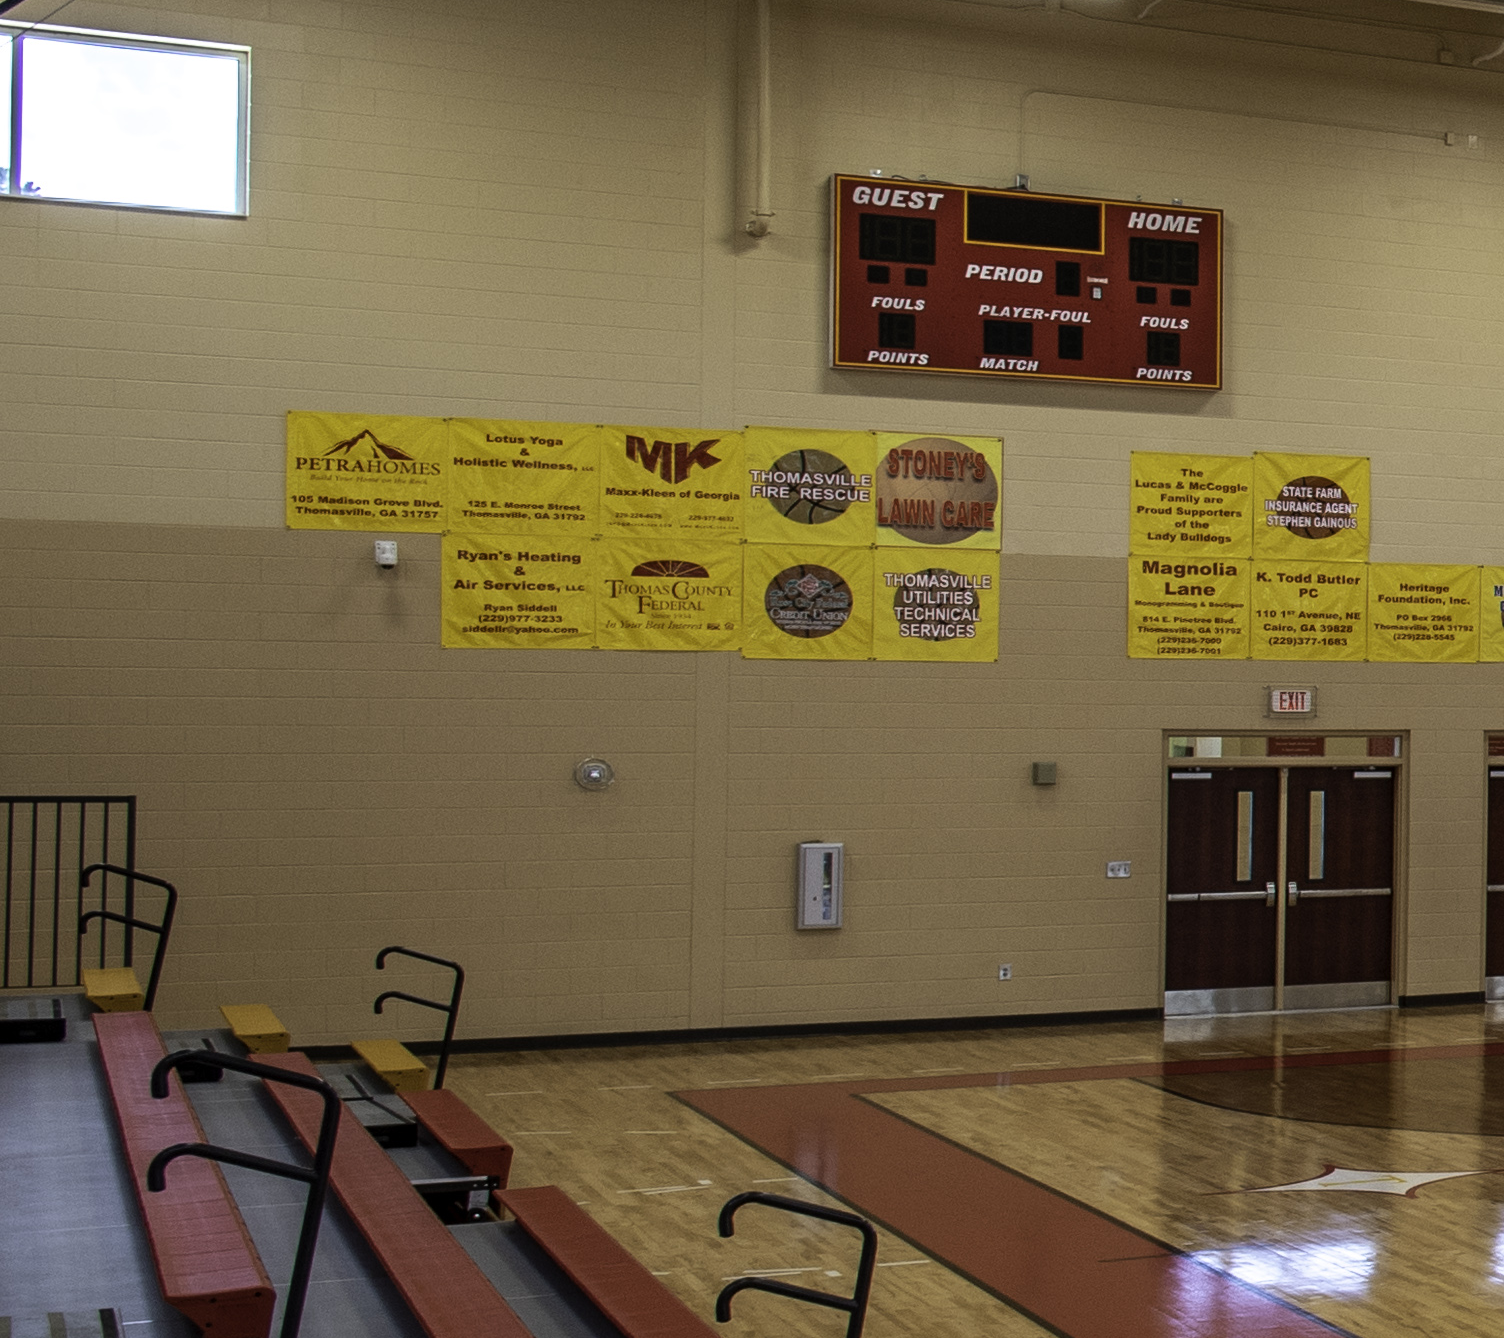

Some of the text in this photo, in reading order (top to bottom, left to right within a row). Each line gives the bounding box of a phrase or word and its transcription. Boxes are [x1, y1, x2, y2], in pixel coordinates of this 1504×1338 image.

[852, 185, 944, 211] GUEST
[1128, 212, 1202, 234] HOME
[965, 264, 1043, 284] PERIOD
[871, 296, 925, 310] FOULS
[978, 304, 1091, 323] PLAYER-FOUL
[1140, 316, 1189, 330] FOULS
[867, 350, 929, 365] POINTS
[980, 358, 1038, 372] MATCH
[1136, 367, 1192, 381] POINTS
[486, 434, 563, 447] Lotus Yoga
[520, 448, 530, 456] &
[296, 457, 441, 476] PETRAHOMES
[454, 457, 578, 471] Holistic Wellness,
[887, 448, 986, 480] STONEY'S
[750, 470, 872, 487] THOMASVILLE
[1181, 469, 1203, 478] The
[606, 487, 740, 501] Maxx-Kleen of Georgia
[751, 486, 870, 502] FIRE RESCUE
[1135, 480, 1248, 494] Lucas & McCoggle
[1283, 486, 1341, 498] STATE FARM
[1161, 494, 1223, 504] Family are
[1137, 506, 1242, 519] Proud Supporters
[1265, 499, 1358, 514] INSURANCE AGENT
[877, 498, 994, 530] LAWN CARE
[1175, 520, 1209, 529] of the
[1267, 515, 1357, 529] STEPHEN GAINOUS
[1148, 532, 1232, 544] Lady Bulldogs
[457, 550, 581, 564] Ryan's Heating
[514, 566, 525, 575] &
[1142, 560, 1237, 578] Magnolia
[454, 580, 478, 590] Air
[484, 580, 561, 592] Services,
[884, 573, 991, 589] THOMASVILLE
[1256, 572, 1361, 586] K. Todd Butler
[1165, 582, 1215, 597] Lane
[1299, 588, 1318, 598] PC
[1400, 583, 1449, 595] Heritage
[903, 591, 973, 604] UTILITIES
[1378, 595, 1470, 606] Foundation, Inc.
[895, 607, 981, 621] TECHNICAL
[900, 624, 975, 638] SERVICES
[1279, 691, 1307, 710] EXIT
